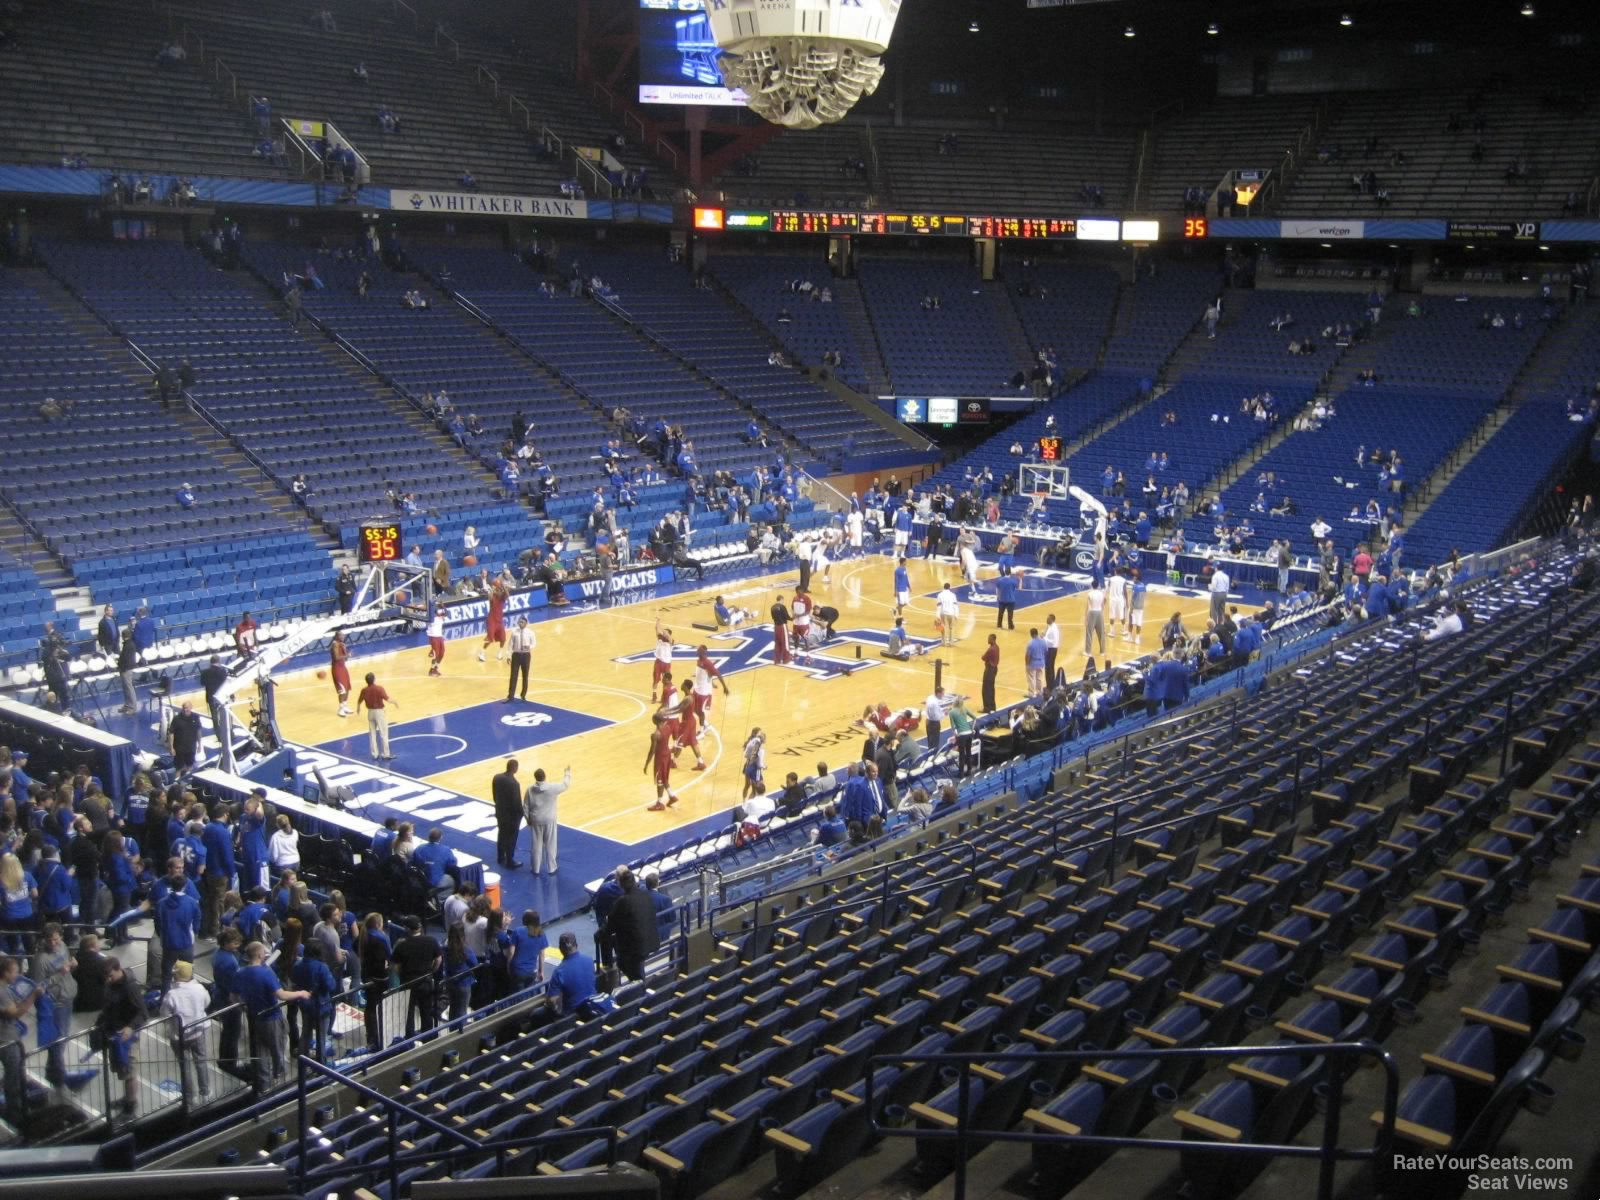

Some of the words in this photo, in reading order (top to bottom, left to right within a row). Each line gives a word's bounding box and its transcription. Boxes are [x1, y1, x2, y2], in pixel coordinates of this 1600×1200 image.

[669, 92, 704, 101] Unlimited
[429, 195, 523, 213] WHITAKER
[531, 200, 575, 216] BANK
[1185, 219, 1205, 238] 35
[1319, 226, 1350, 237] verizon
[1516, 223, 1536, 237] yp
[365, 527, 398, 541] 55:15
[370, 539, 395, 559] 35
[580, 569, 658, 597] WIDCATS
[772, 726, 866, 757] ARENA
